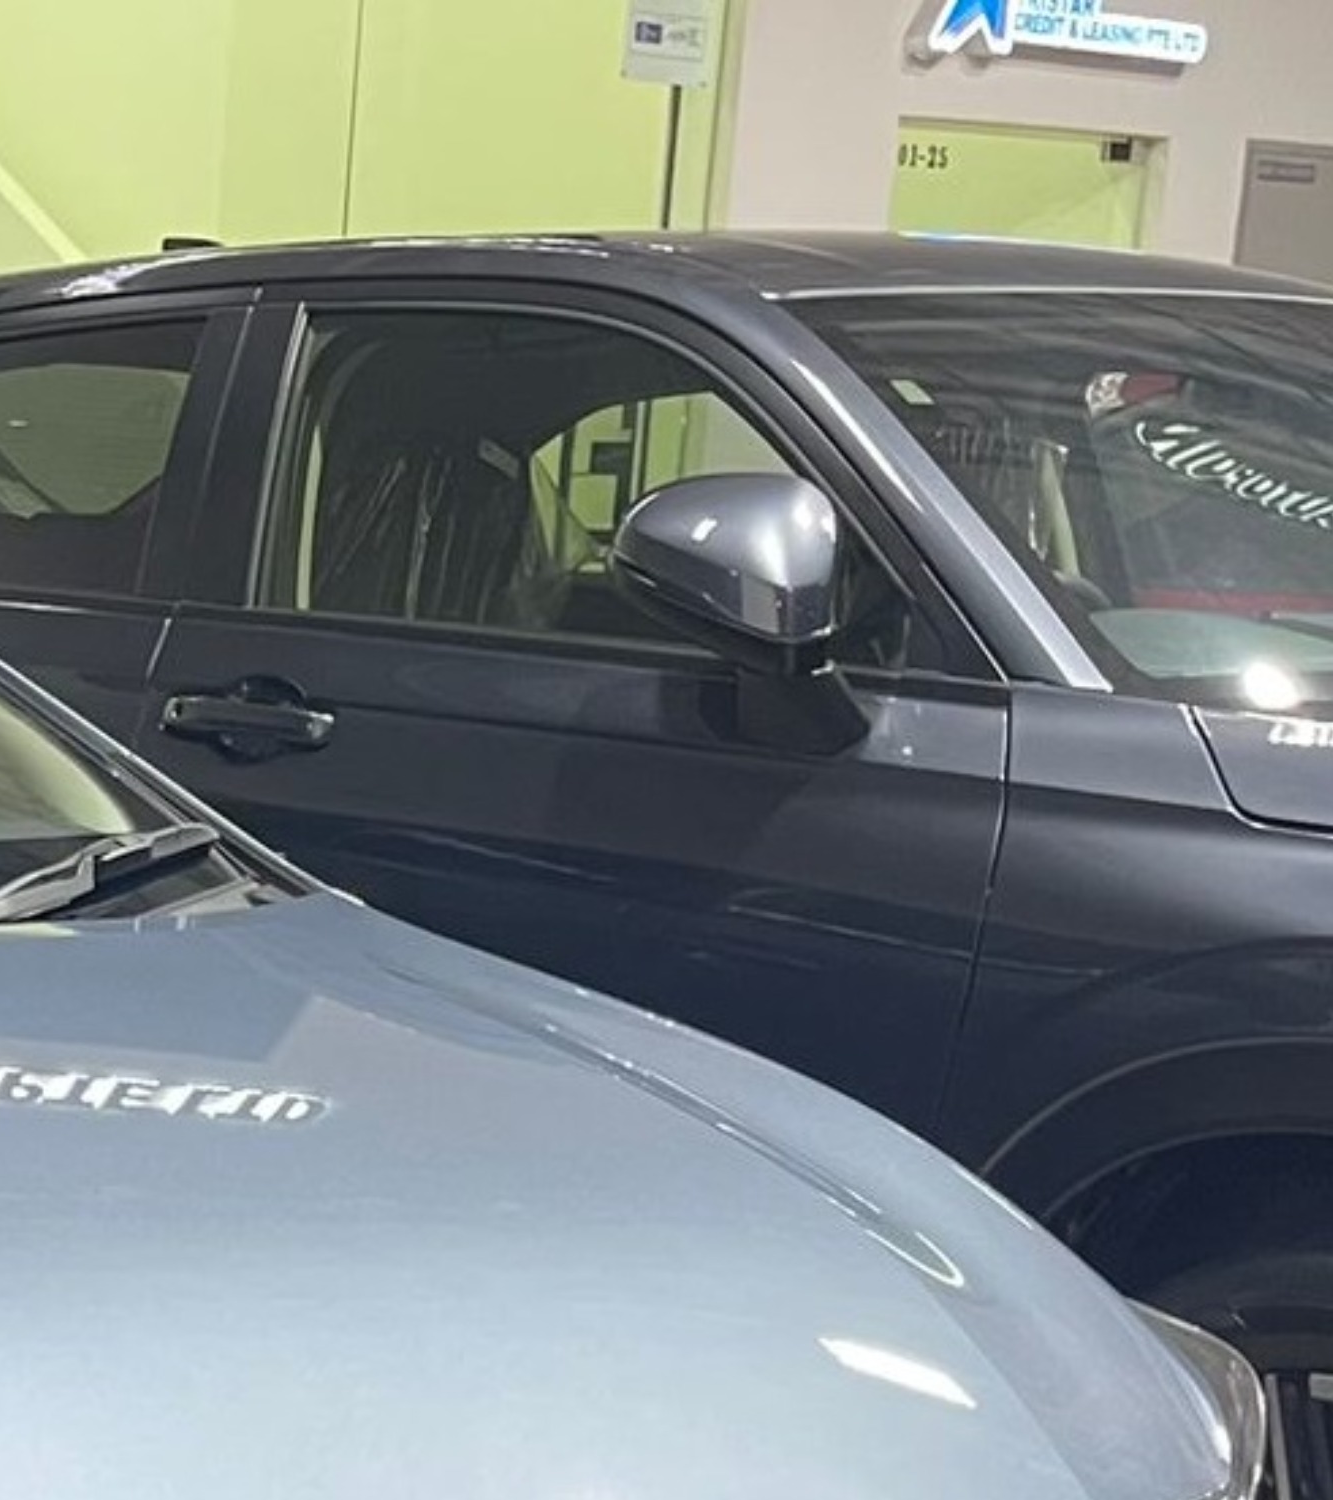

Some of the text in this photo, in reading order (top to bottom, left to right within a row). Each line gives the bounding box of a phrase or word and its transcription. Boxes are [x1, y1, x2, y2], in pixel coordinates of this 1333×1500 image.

[1014, 14, 1065, 35] CREDIT
[1082, 21, 1142, 44] LEASING
[899, 144, 948, 169] 01-25
